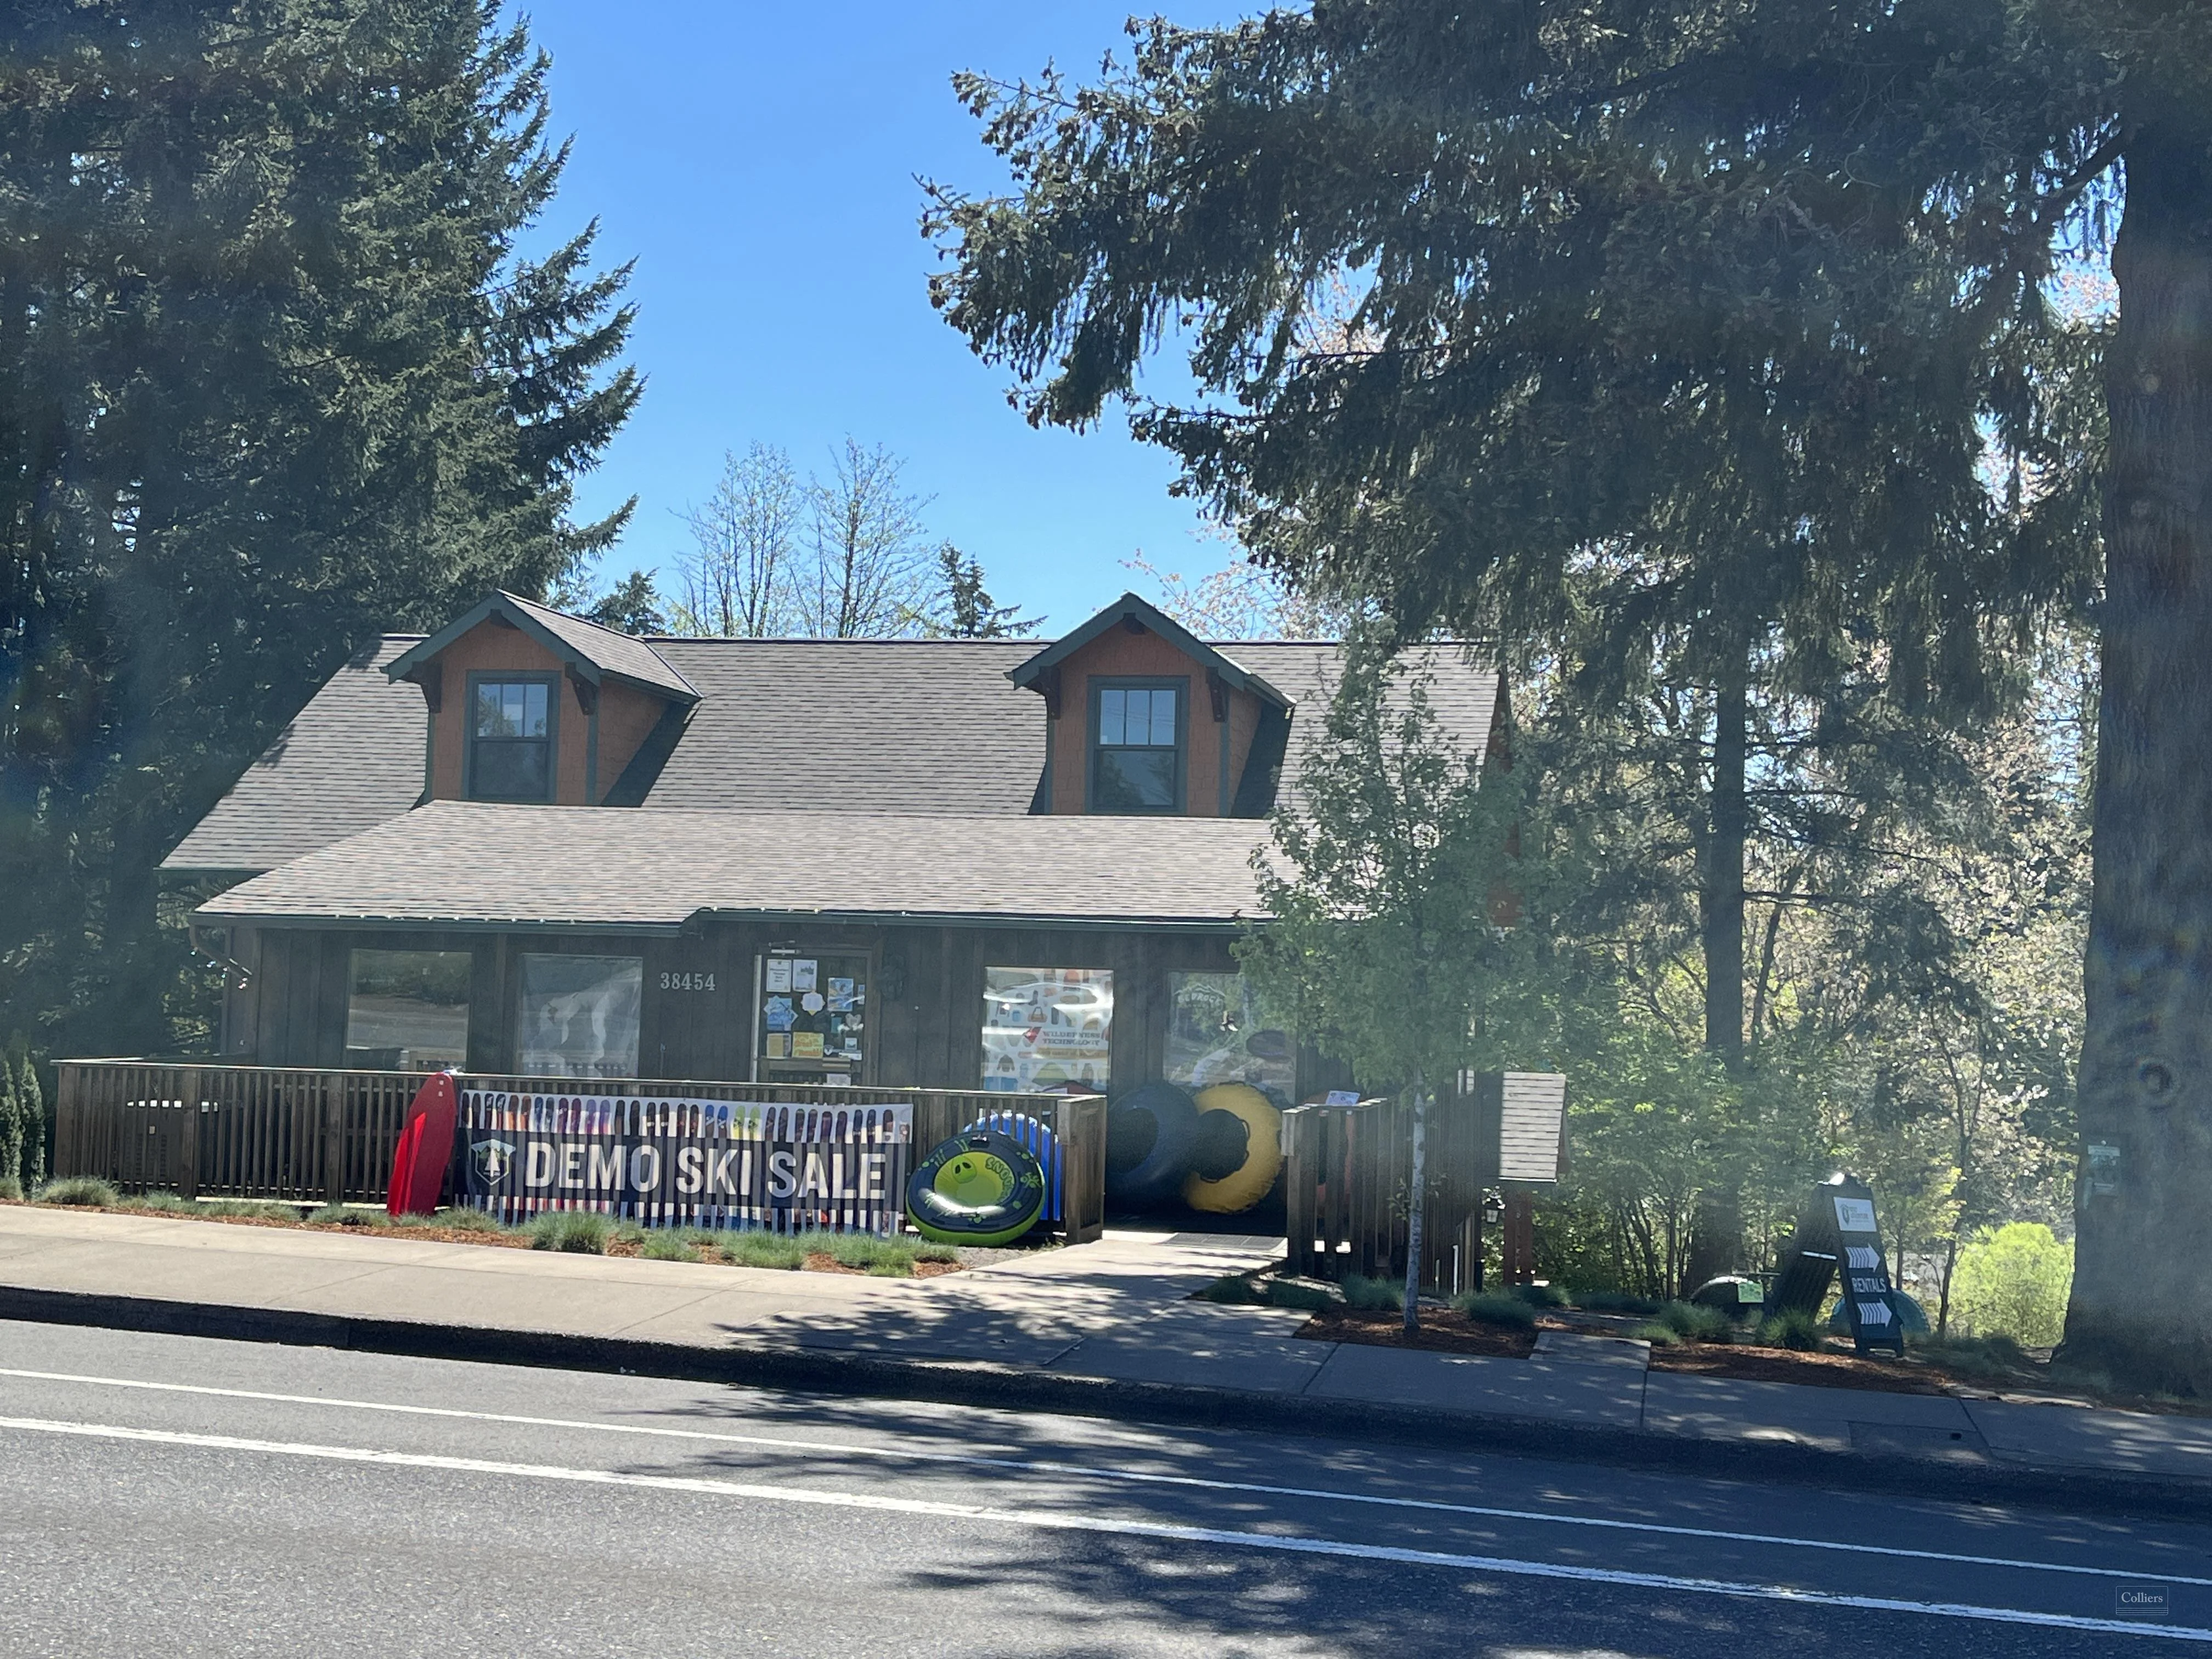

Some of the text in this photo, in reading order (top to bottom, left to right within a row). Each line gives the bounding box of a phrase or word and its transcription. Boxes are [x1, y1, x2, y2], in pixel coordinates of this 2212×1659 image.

[660, 972, 716, 991] 38454
[525, 1141, 886, 1199] DEMO SKI SALE
[1852, 1277, 1887, 1293] RENTALS
